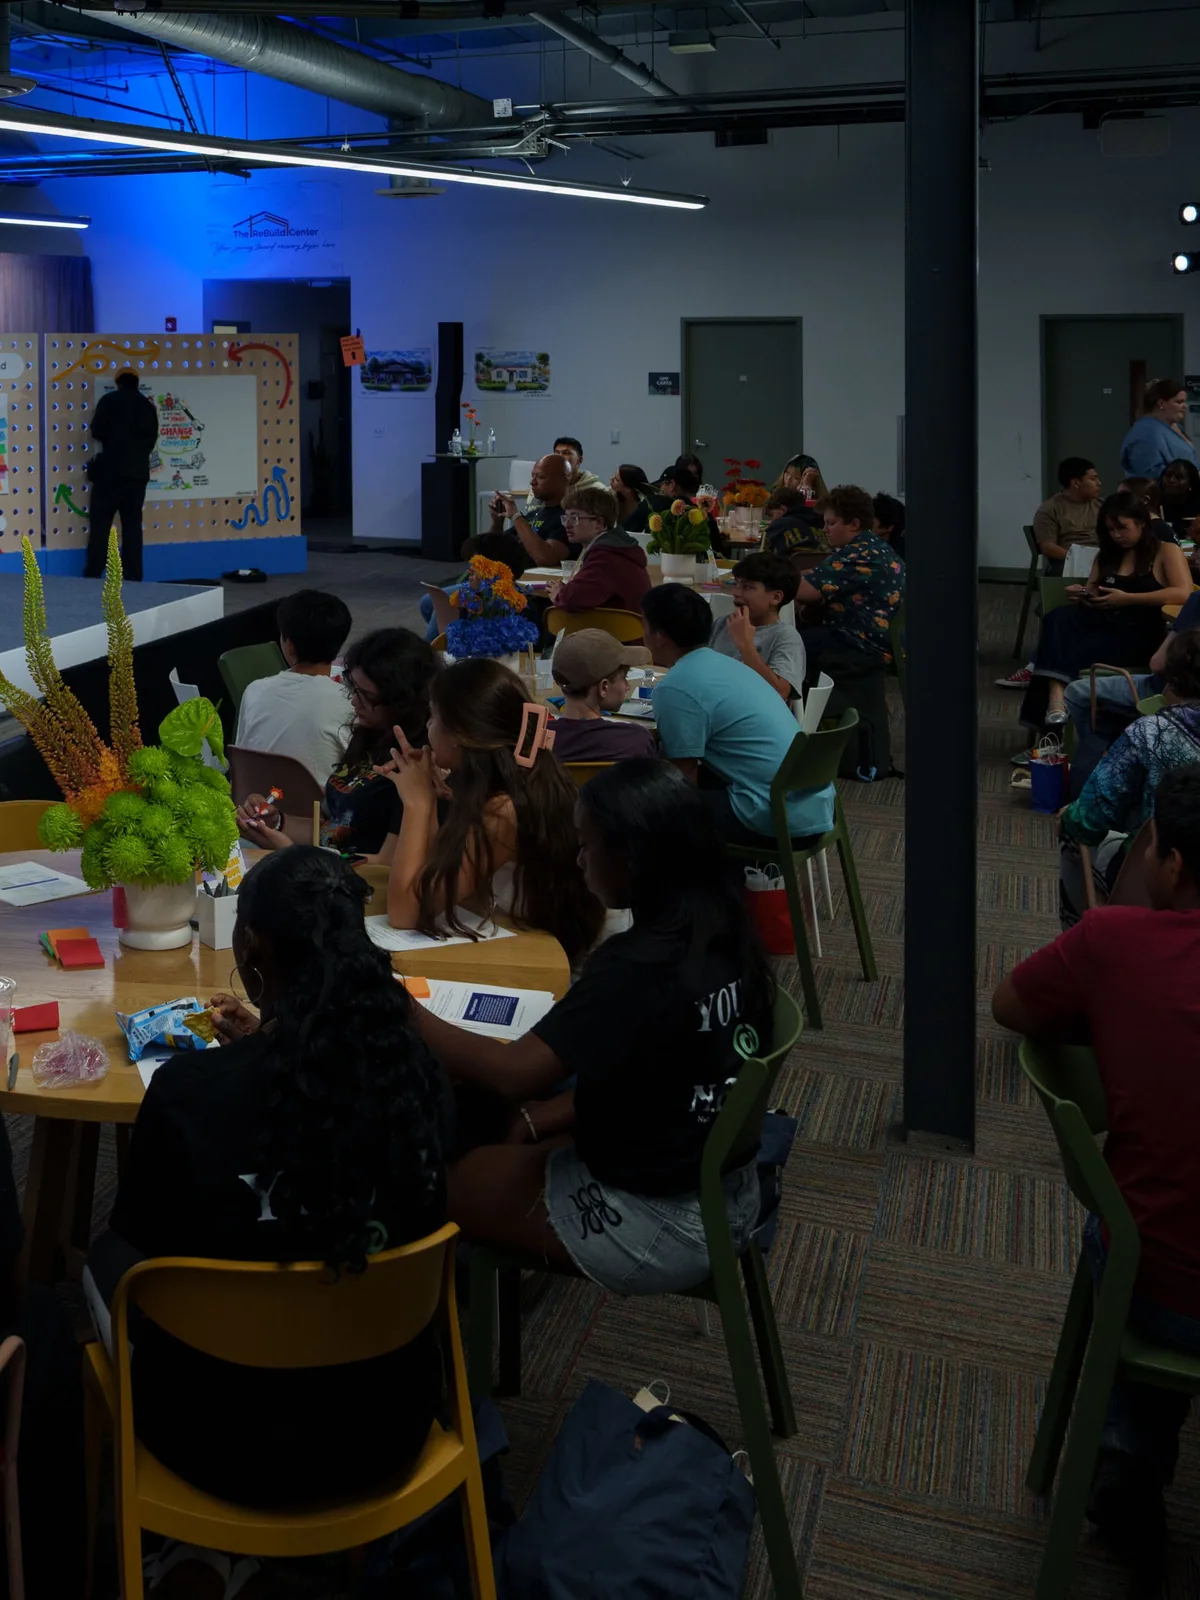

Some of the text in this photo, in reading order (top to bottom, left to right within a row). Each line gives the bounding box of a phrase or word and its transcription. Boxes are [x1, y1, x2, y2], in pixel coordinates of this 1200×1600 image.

[233, 227, 319, 239] The ReBuild Center
[160, 427, 193, 436] CHANGE
